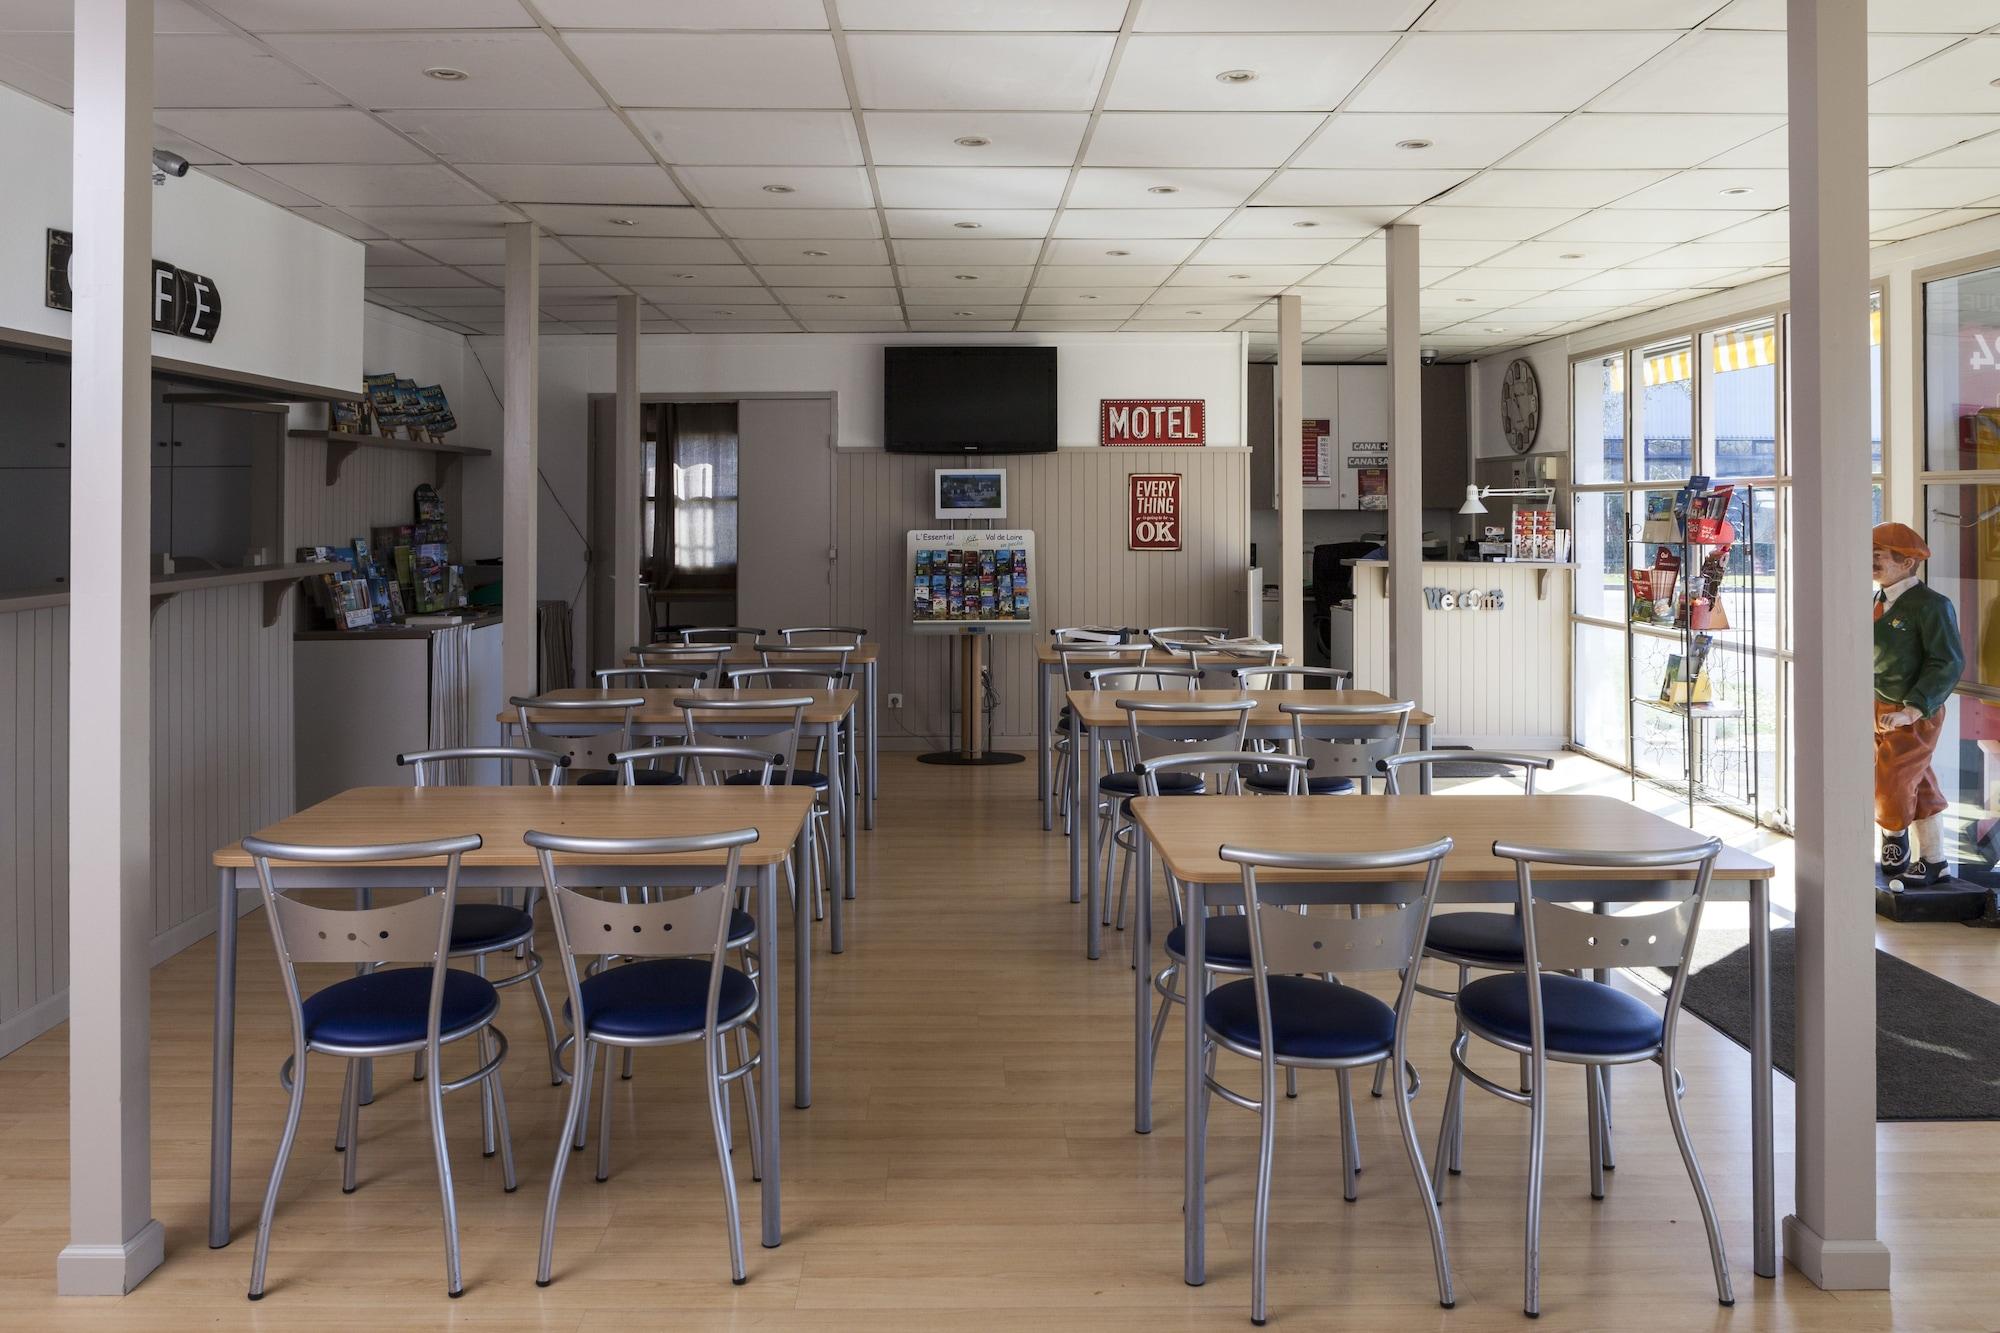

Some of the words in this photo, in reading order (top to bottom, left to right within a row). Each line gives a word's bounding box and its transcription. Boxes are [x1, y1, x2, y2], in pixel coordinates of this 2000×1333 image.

[1109, 406, 1198, 438] MOTEL
[1137, 481, 1175, 497] EVERY
[1137, 498, 1174, 514] THING
[916, 533, 955, 541] L'Essentiel
[986, 533, 997, 541] Val
[997, 533, 1006, 541] de
[1007, 533, 1023, 541] Loire
[1136, 521, 1176, 542] OK
